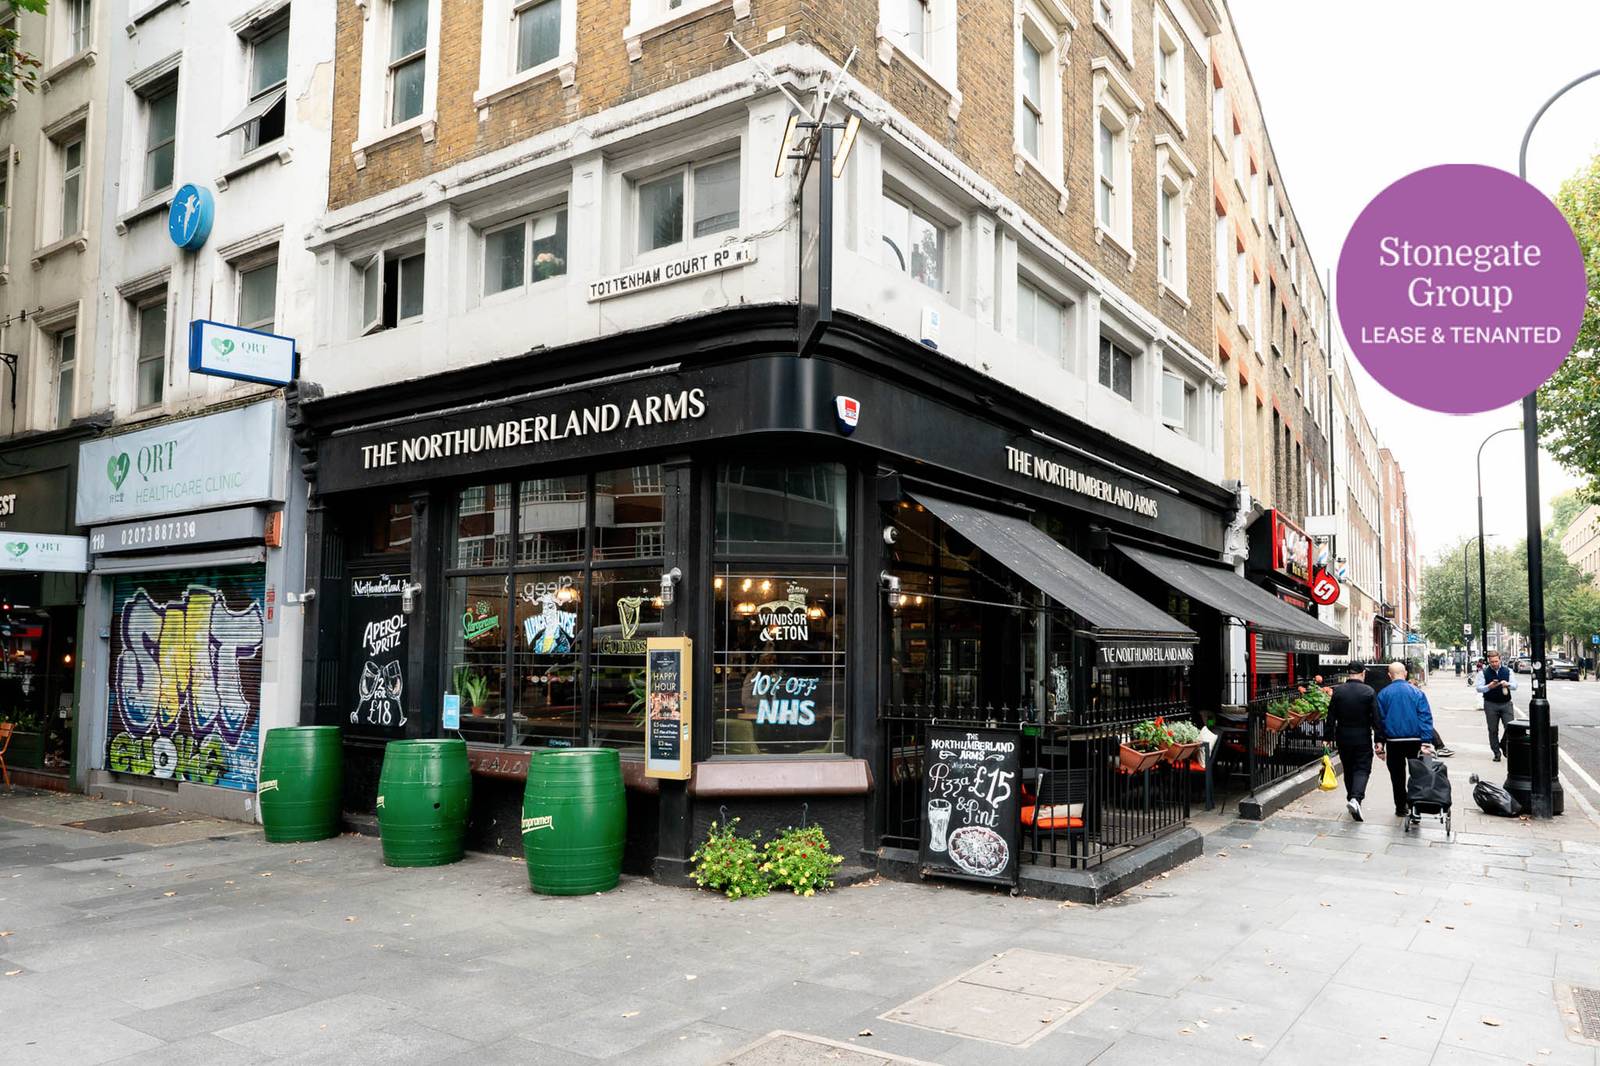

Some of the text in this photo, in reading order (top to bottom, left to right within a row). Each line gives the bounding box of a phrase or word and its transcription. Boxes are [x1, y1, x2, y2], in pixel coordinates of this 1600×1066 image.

[590, 267, 661, 297] TOTTENHAM
[666, 256, 708, 279] COURT
[241, 342, 268, 354] QRT
[361, 388, 706, 470] THE NORTHUMBERLAND ARMS
[137, 440, 178, 482] QRT
[136, 479, 202, 504] HEALTHCARE
[205, 471, 242, 493] CLINIC
[1005, 446, 1159, 518] THE NORTHUMBERLAND ARMS
[35, 542, 61, 552] QRT
[91, 533, 105, 550] 118
[363, 614, 408, 648] APEROL
[758, 613, 807, 626] WINDSOR
[370, 631, 401, 657] SPRITZ
[759, 625, 809, 642] & ETON
[377, 678, 386, 690] 2
[653, 673, 678, 681] HAPPY
[654, 682, 676, 691] HOUR
[751, 671, 819, 696] 10% OFF
[367, 700, 392, 725] £18
[755, 699, 816, 726] NHS
[931, 739, 1015, 753] NORTHUMBERLAND
[959, 750, 986, 761] ARMS
[928, 763, 1015, 809] Pizza £15
[956, 797, 1000, 827] & Pint
